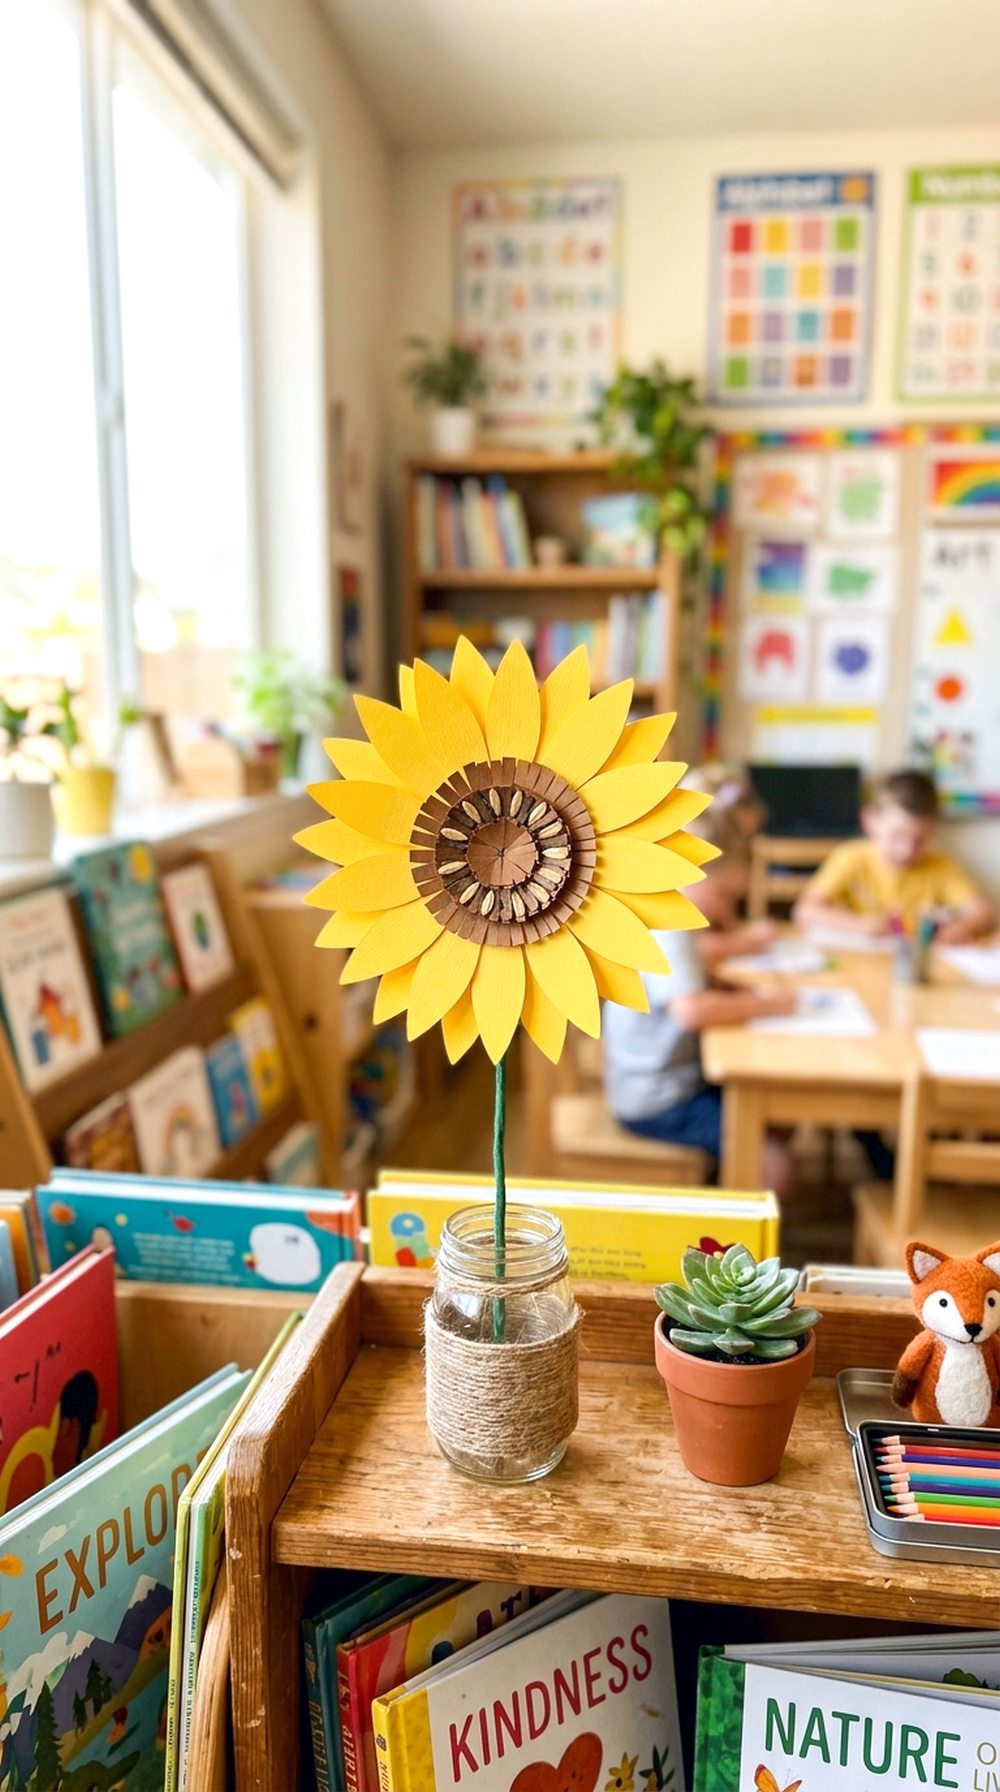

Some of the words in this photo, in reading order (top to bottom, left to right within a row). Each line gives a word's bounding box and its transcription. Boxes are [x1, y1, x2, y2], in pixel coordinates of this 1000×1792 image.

[34, 1444, 210, 1636] EXPLO
[449, 1623, 652, 1783] KINDNESS
[764, 1697, 961, 1789] NATURE
